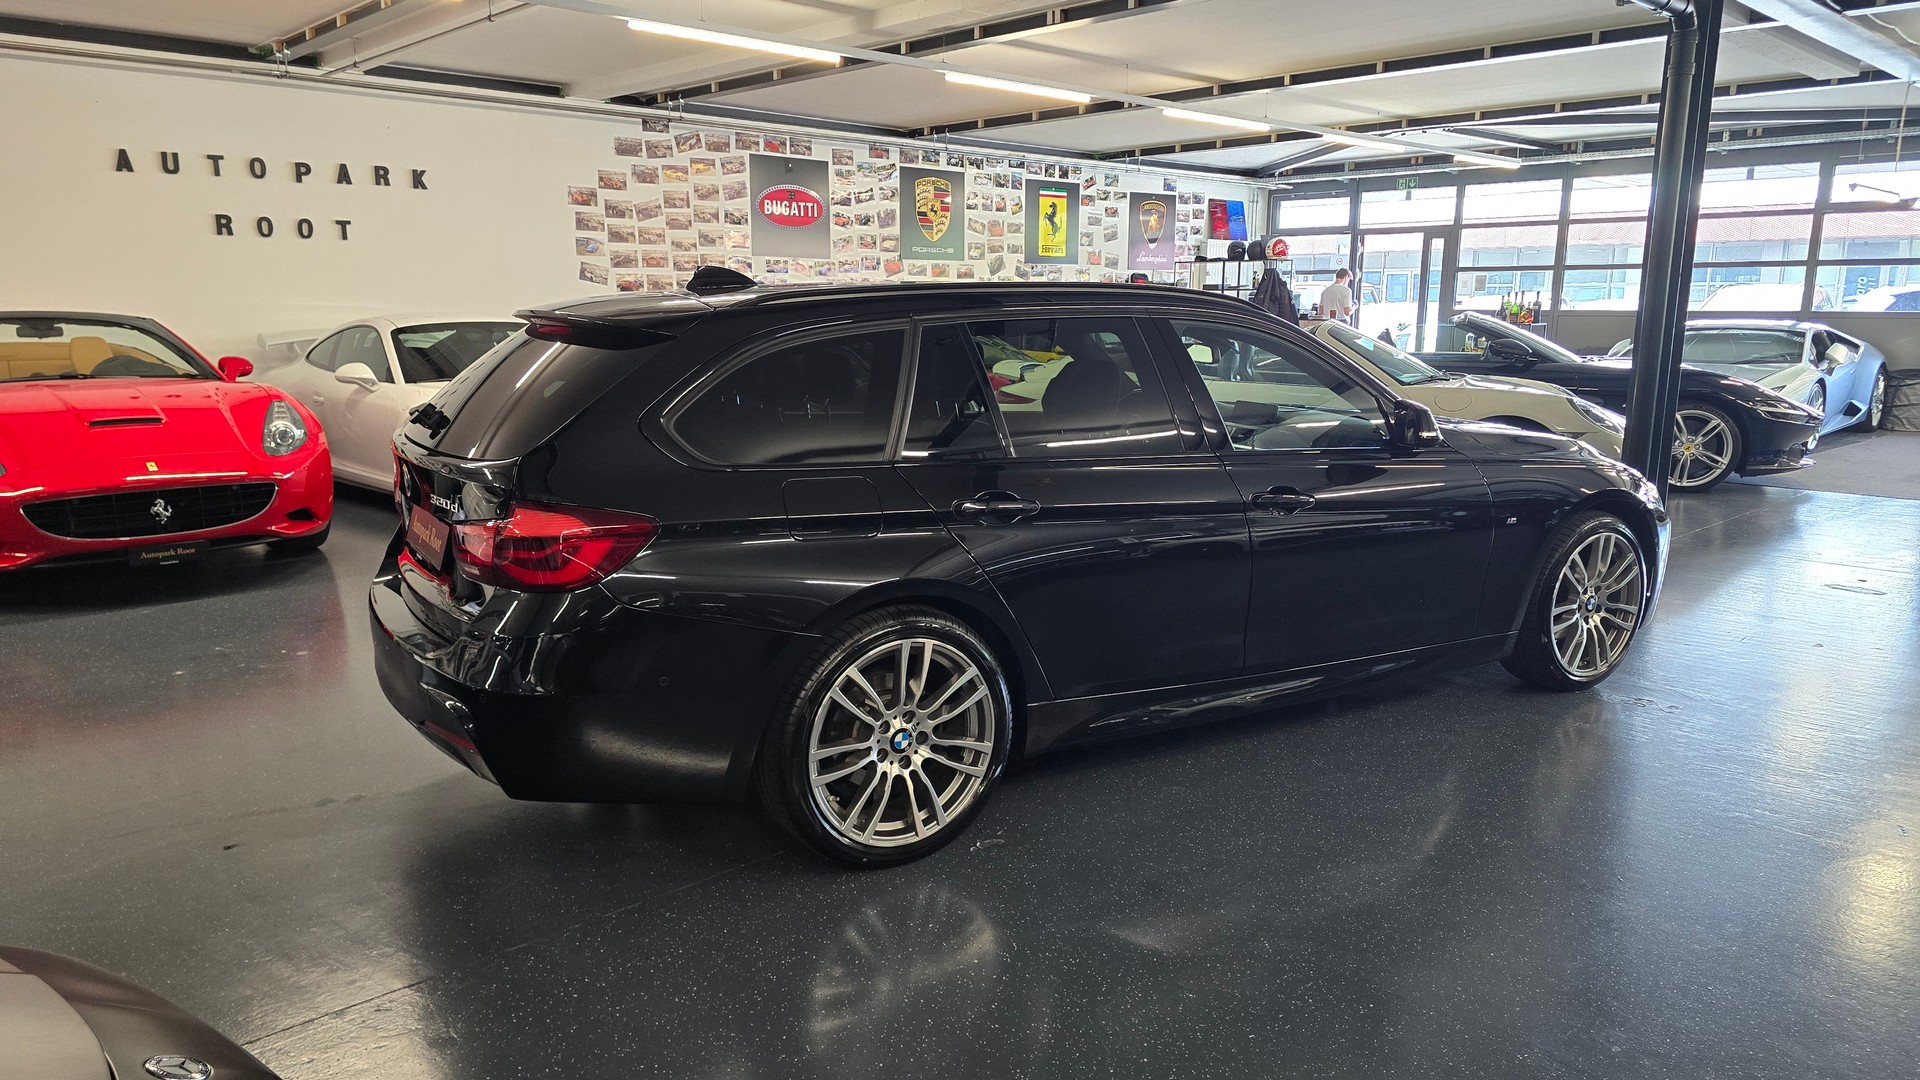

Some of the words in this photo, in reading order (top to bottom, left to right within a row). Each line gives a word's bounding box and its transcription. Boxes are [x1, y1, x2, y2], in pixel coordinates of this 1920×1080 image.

[115, 148, 428, 190] AUTOPARK
[916, 179, 950, 190] PORSCHE
[763, 199, 819, 218] BUGATTI
[215, 214, 352, 241] ROOT
[912, 246, 954, 254] PORSCHE
[1041, 244, 1065, 254] Ferrari
[430, 493, 459, 514] 320d
[412, 514, 432, 543] Autopark
[430, 527, 442, 553] Root
[140, 548, 176, 559] Autopark
[177, 547, 196, 555] Root
